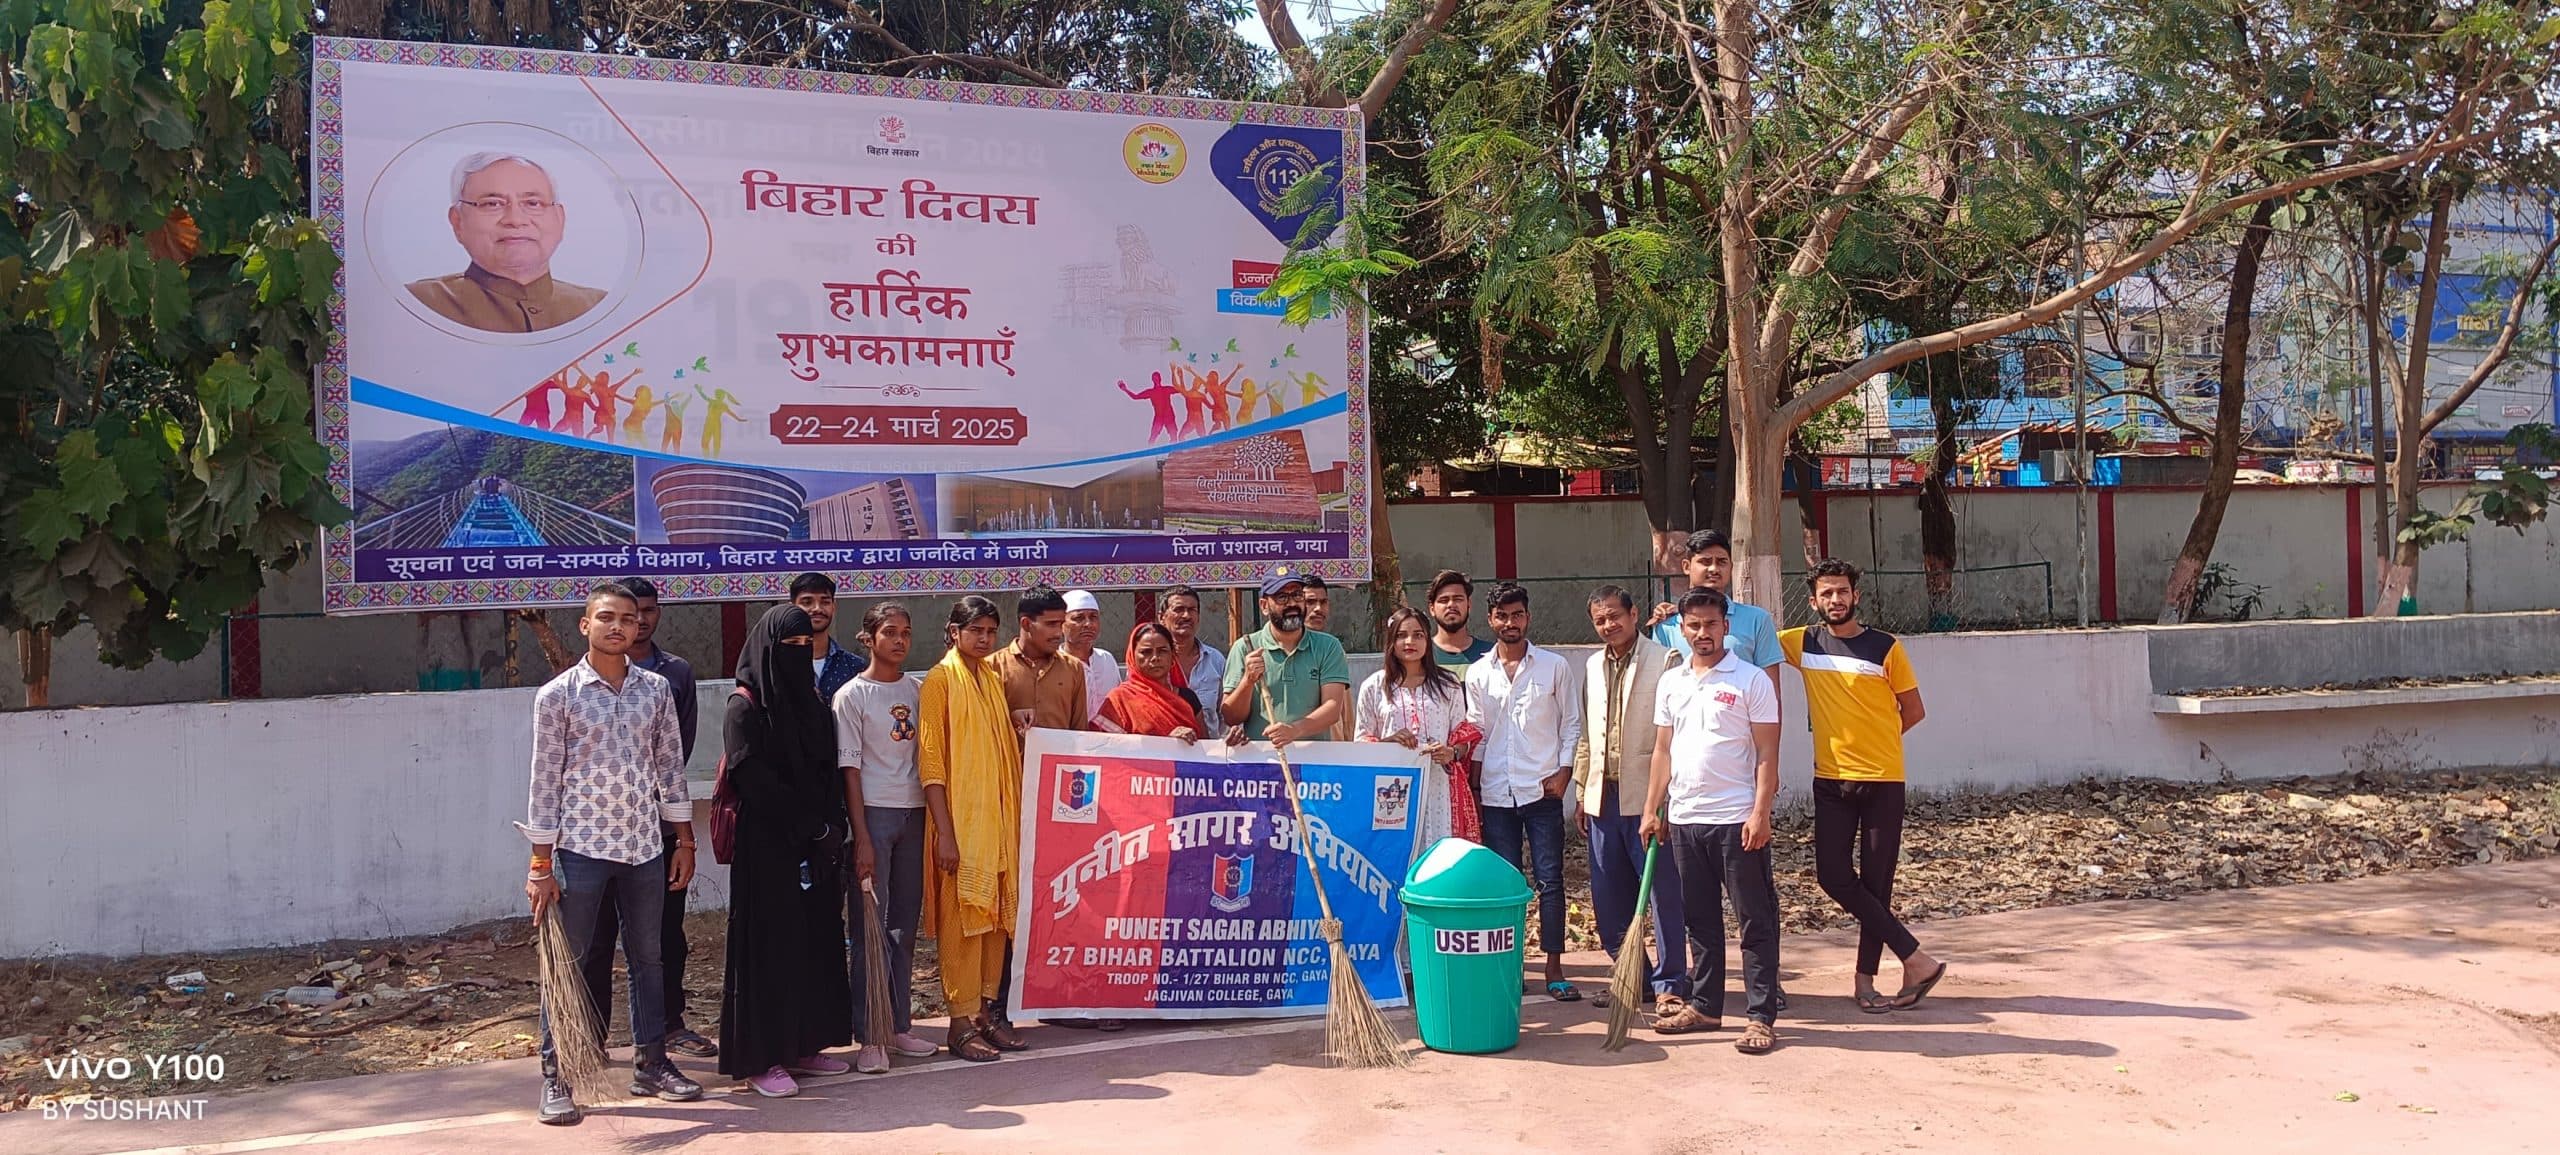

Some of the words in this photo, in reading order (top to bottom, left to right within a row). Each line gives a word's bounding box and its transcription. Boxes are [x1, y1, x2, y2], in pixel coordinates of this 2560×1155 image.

[866, 144, 889, 156] बिहार
[891, 147, 920, 159] सरकार
[1268, 168, 1299, 185] 113
[740, 168, 889, 218] बिहार
[899, 178, 1041, 226] दिवस
[875, 232, 917, 257] की
[1237, 271, 1275, 285] उन्नत
[821, 268, 972, 323] हार्दिक
[776, 325, 1018, 382] शुभकामनाएँ
[888, 409, 941, 439] मार्च
[951, 417, 1015, 441] 2025
[1216, 469, 1249, 481] bihar
[1228, 484, 1286, 495] museum
[386, 550, 453, 580] सूचना
[462, 548, 496, 573] एवं
[637, 547, 712, 571] विभाग,
[719, 545, 776, 568] बिहार
[783, 546, 852, 567] सरकार
[860, 547, 902, 565] द्वारा
[908, 540, 977, 562] जनहित
[982, 540, 1001, 561] में
[1007, 539, 1049, 560] जारी
[1172, 536, 1217, 557] जिला
[1222, 537, 1289, 557] प्रशासन,
[1296, 537, 1328, 555] गया
[1130, 775, 1218, 799] NATIONAL
[1223, 777, 1277, 801] CADET
[1050, 823, 1155, 920] पुनीत
[1166, 810, 1257, 852] सागर
[1269, 813, 1393, 914] अभियान
[1104, 917, 1184, 941] PUNEET
[1186, 918, 1257, 941] SAGAR
[1436, 930, 1479, 953] USE
[1487, 928, 1514, 952] ME
[1046, 947, 1075, 966] 27
[1083, 946, 1153, 967] BIHAR
[1160, 947, 1276, 967] BATTALION
[1283, 947, 1328, 966] NCC,
[1347, 943, 1380, 961] AYA
[1107, 972, 1148, 985] TROOP
[1153, 972, 1179, 985] NO.-
[1183, 971, 1209, 985] 1/27
[1213, 971, 1248, 985] BIHAR
[1253, 971, 1270, 985] BN
[1302, 970, 1328, 982] GAYA
[1143, 988, 1203, 1001] JAGJIVAN
[1207, 988, 1262, 1002] COLLEGE,
[1266, 987, 1294, 1000] GAYA
